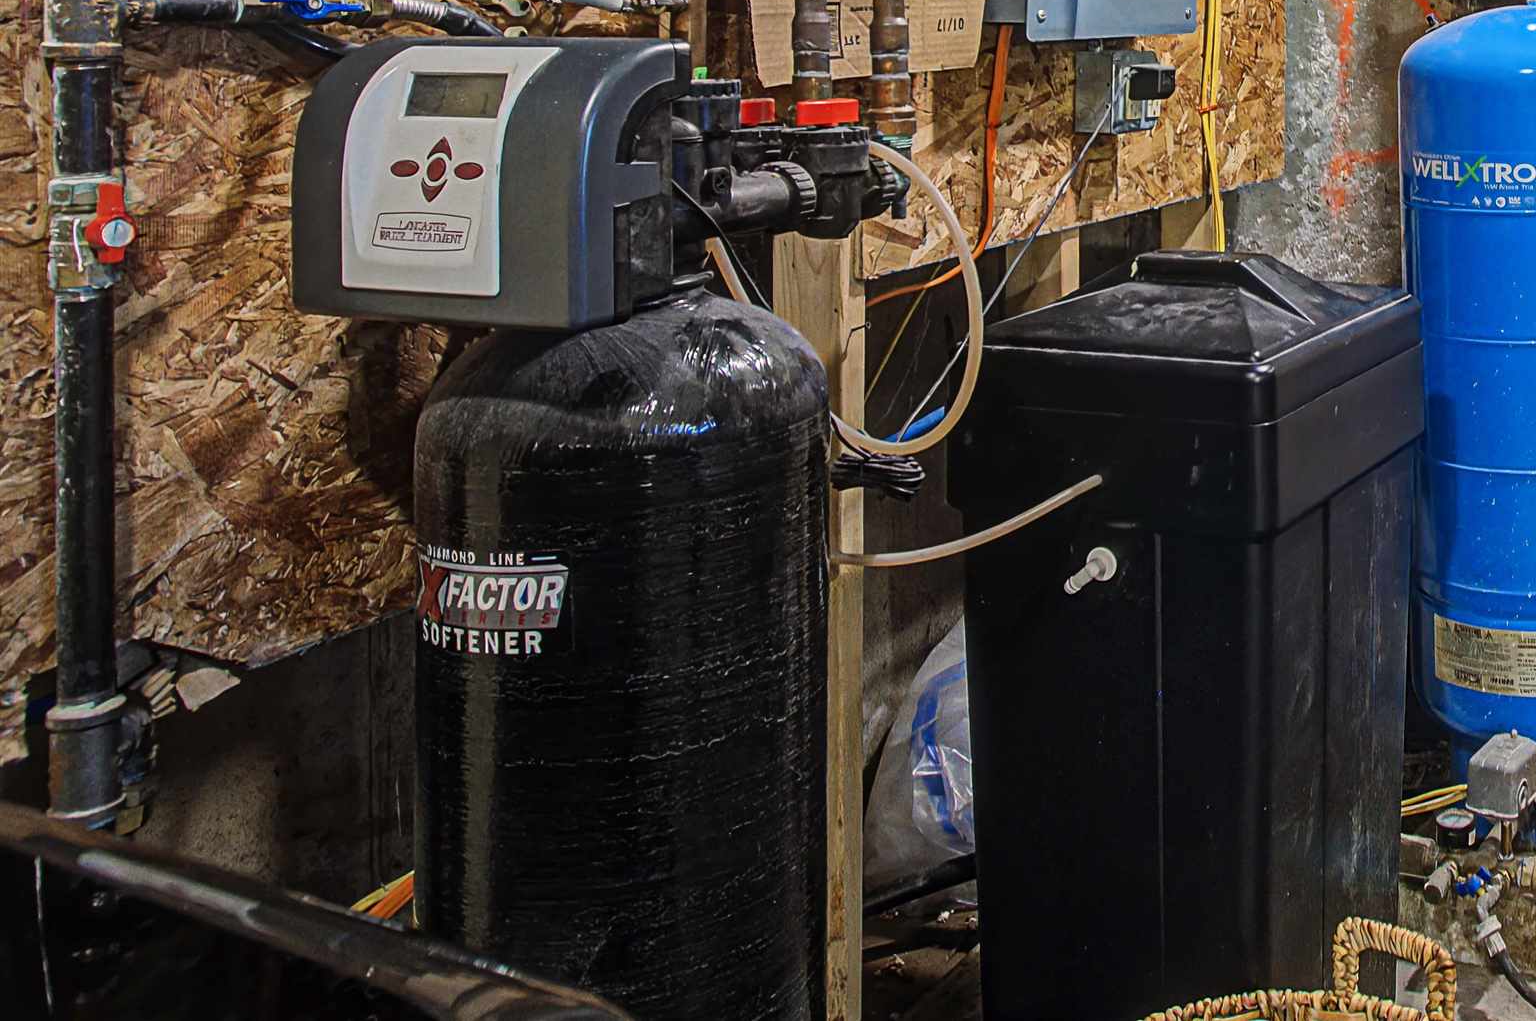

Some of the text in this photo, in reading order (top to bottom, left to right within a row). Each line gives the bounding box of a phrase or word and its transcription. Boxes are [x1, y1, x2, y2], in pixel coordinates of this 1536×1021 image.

[427, 544, 525, 566] DIAMOND LINE
[422, 617, 543, 655] SOFTENER
